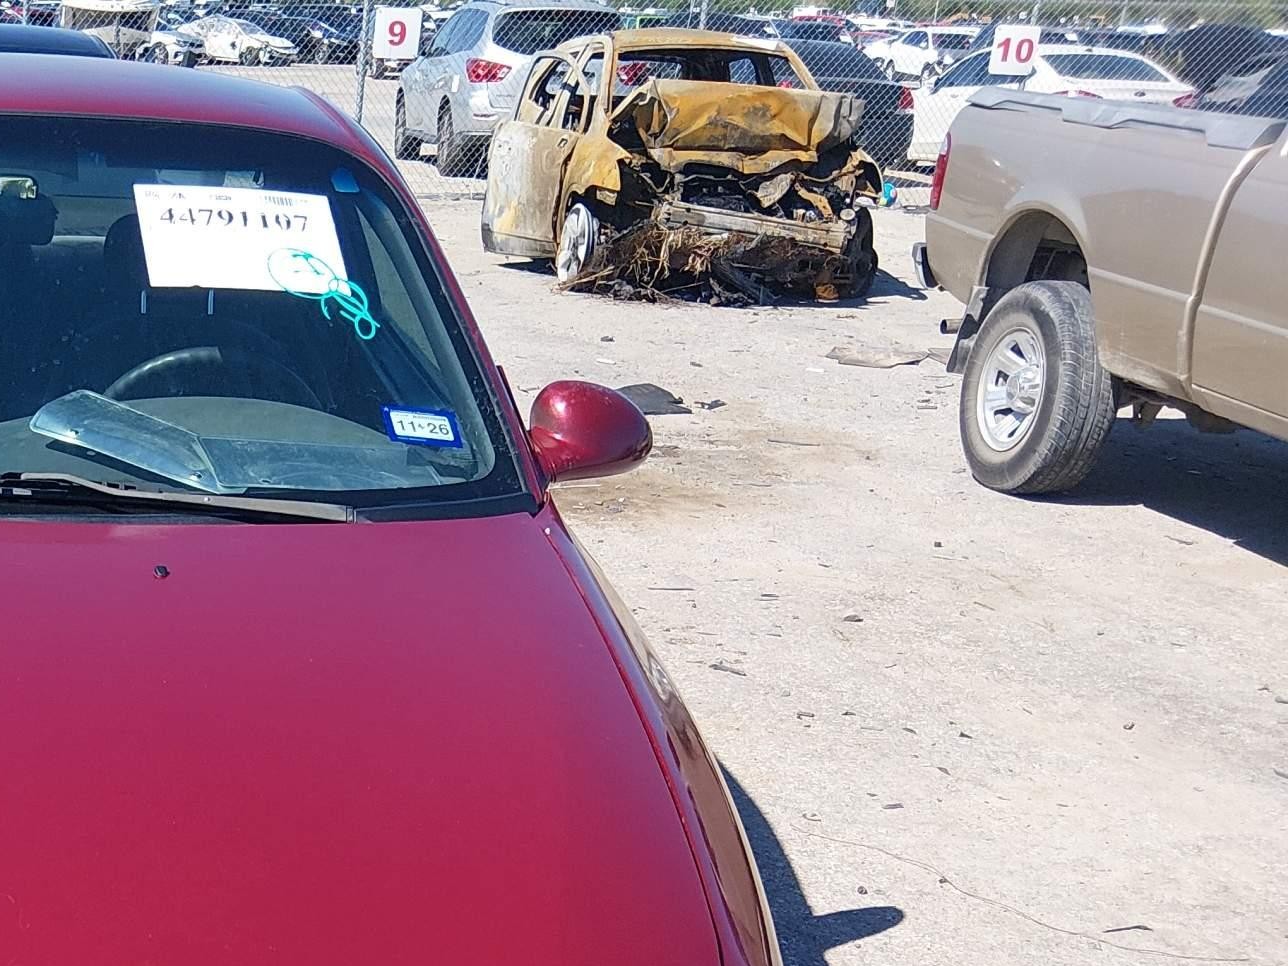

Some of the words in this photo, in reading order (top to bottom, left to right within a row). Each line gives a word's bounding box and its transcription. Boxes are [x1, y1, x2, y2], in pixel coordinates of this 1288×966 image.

[388, 20, 407, 46] 9
[997, 37, 1034, 64] 10
[160, 207, 308, 232] 44791107
